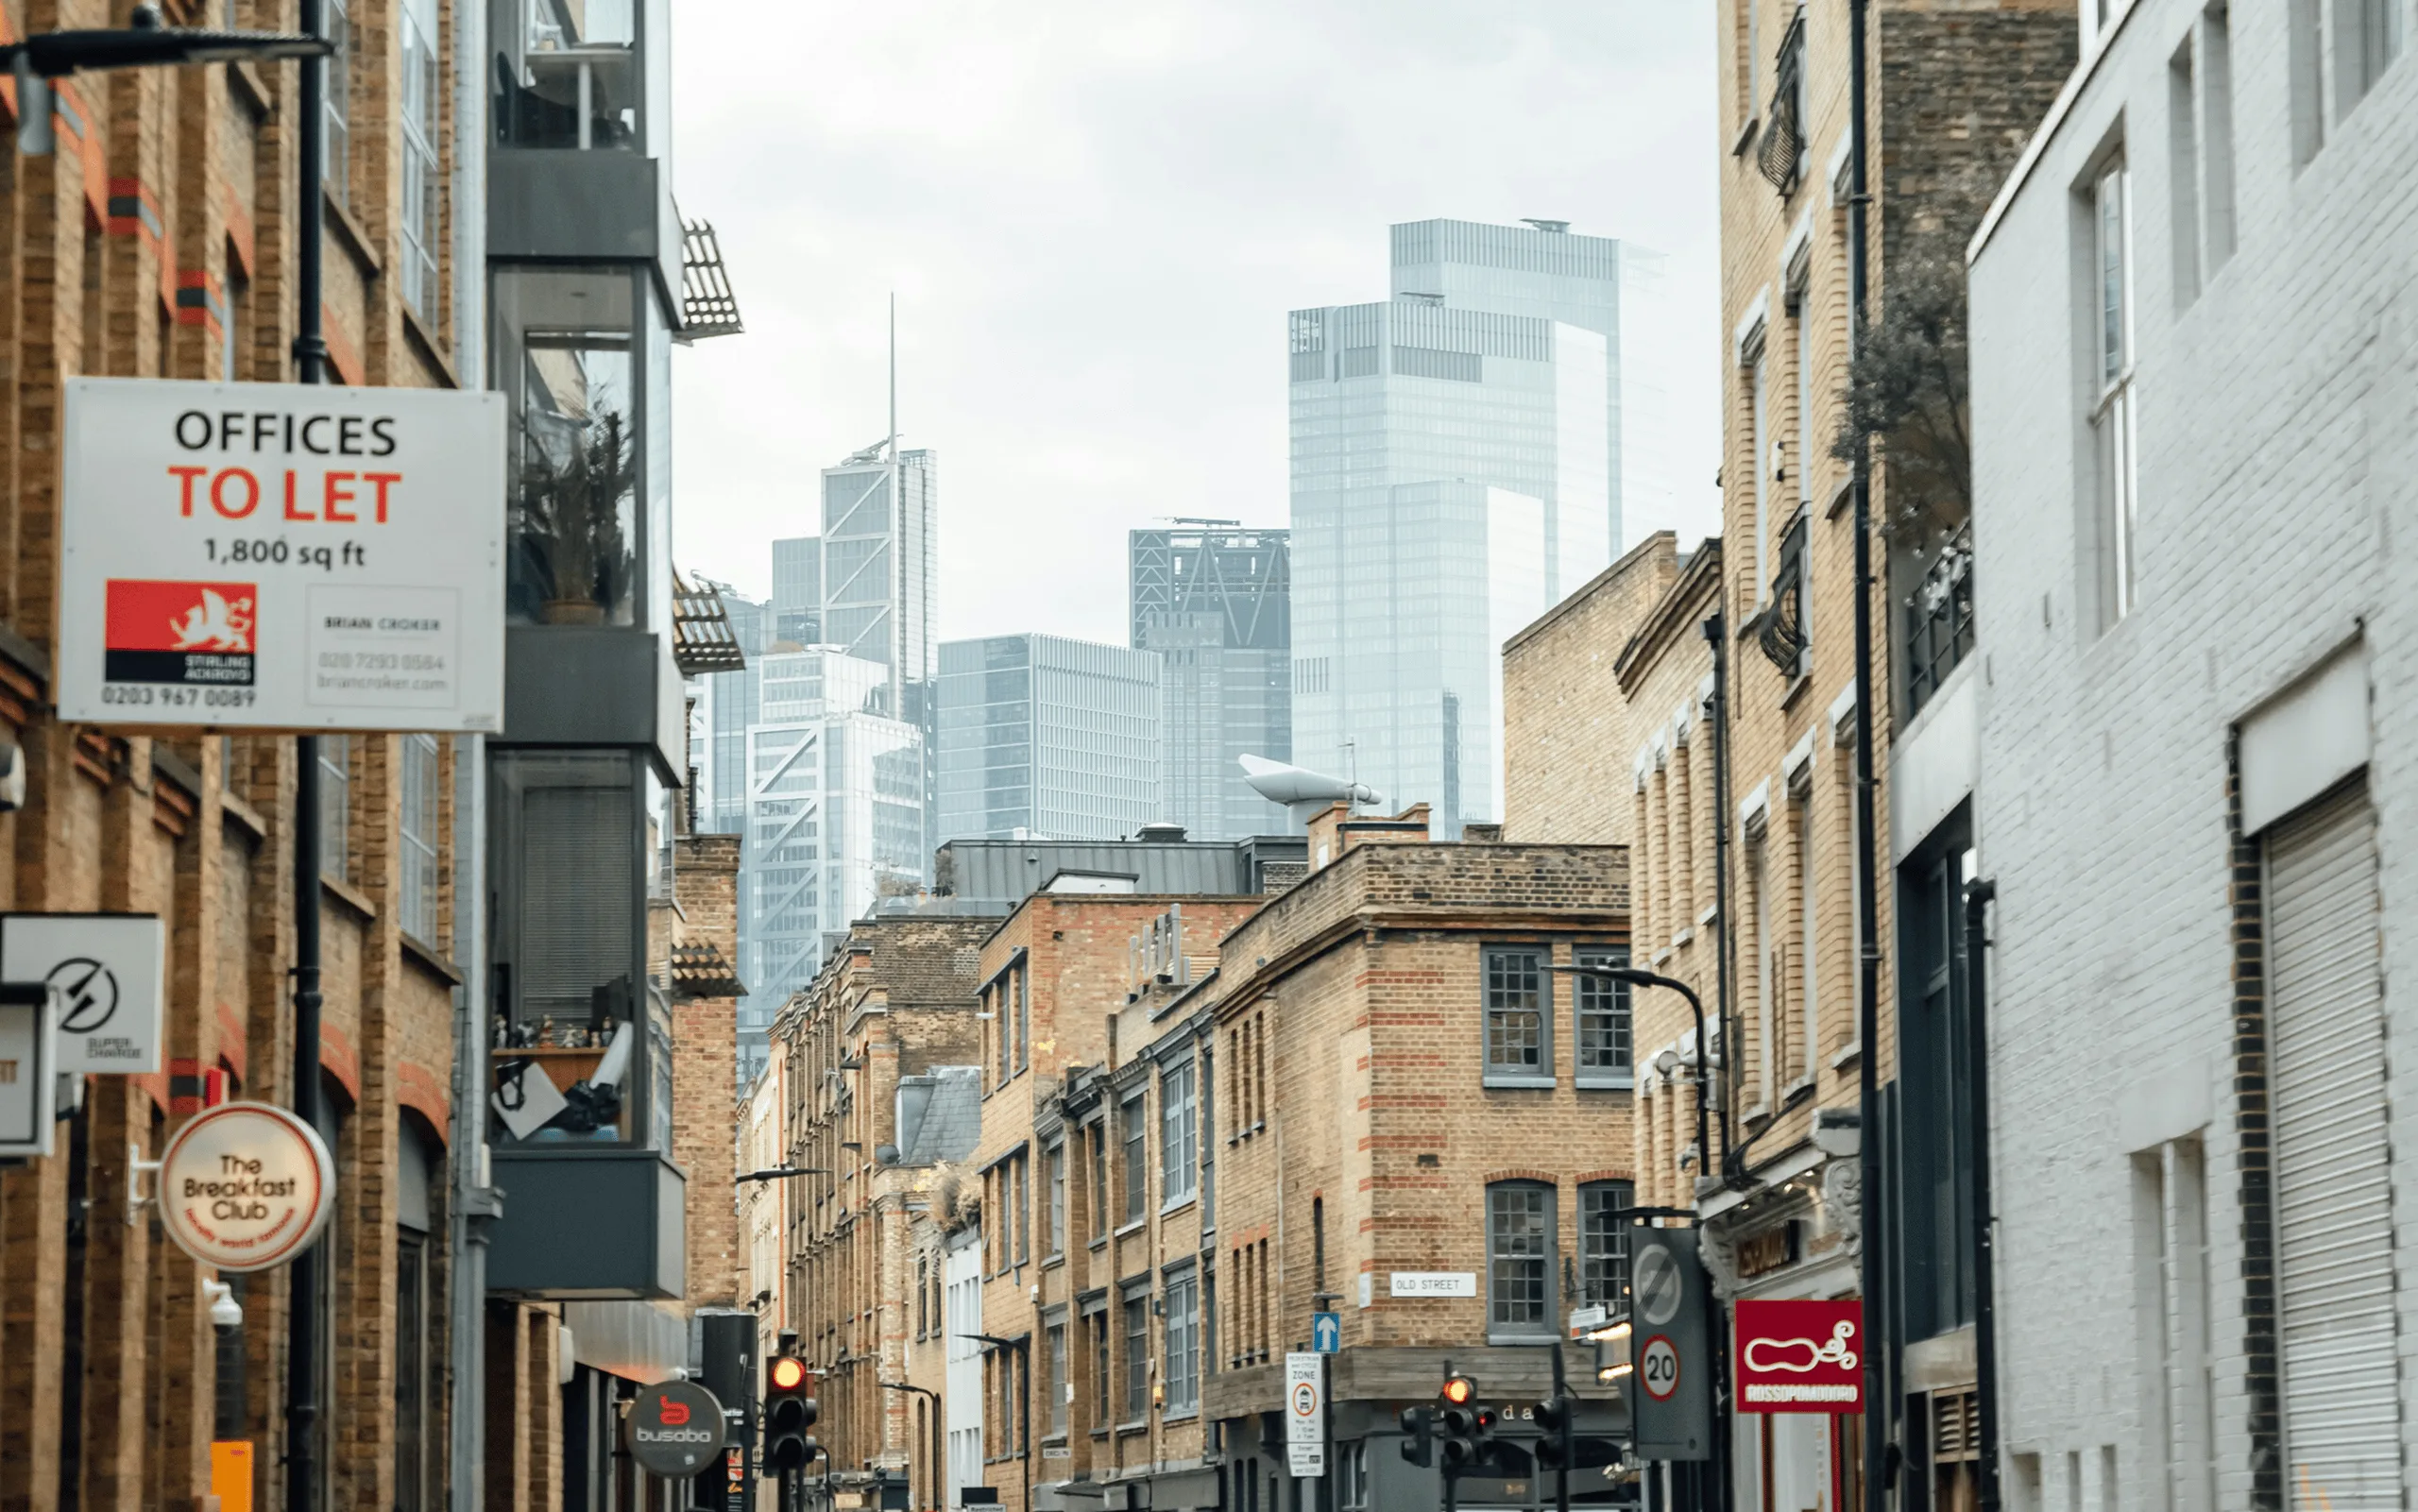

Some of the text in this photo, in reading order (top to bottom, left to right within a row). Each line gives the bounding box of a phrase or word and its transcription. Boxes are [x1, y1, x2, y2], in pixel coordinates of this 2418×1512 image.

[175, 410, 397, 457] OFFICES
[167, 466, 402, 524] TO LET
[204, 537, 366, 571] 1,800 sq ft
[324, 617, 372, 629] BRIAN
[184, 654, 251, 668] STIRLING
[101, 686, 154, 705] 0203
[160, 688, 199, 705] 967
[220, 1154, 262, 1175] The
[184, 1177, 296, 1198] Breakfast
[212, 1199, 269, 1220] Club
[1396, 1279, 1460, 1290] OLD STREET
[1292, 1370, 1316, 1380] ZONE
[1646, 1354, 1676, 1382] 20
[1745, 1384, 1858, 1402] ROSSOPOMODORO
[636, 1427, 712, 1443] busaba
